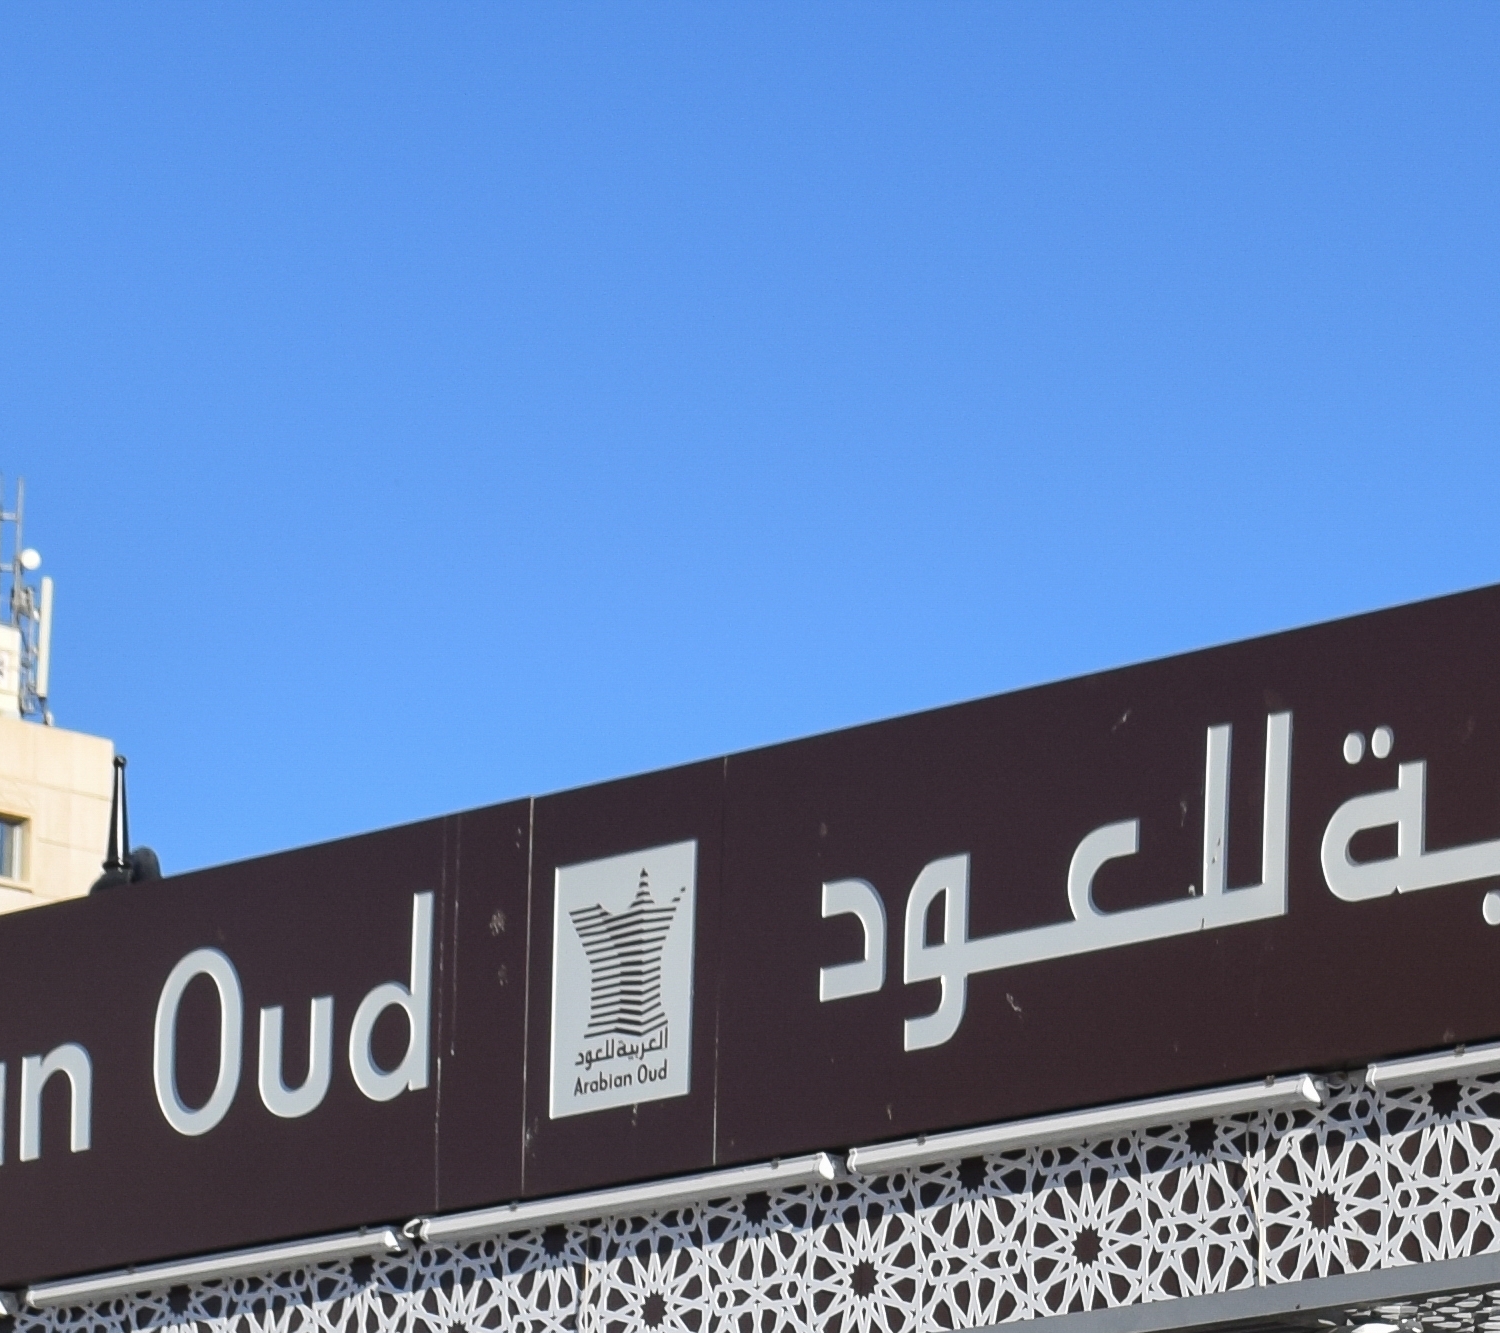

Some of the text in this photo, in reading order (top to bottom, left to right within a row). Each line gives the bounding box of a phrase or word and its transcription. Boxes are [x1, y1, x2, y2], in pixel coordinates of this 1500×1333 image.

[818, 710, 1293, 1052] للعود
[152, 891, 434, 1137] Oud
[573, 1058, 668, 1097] Arabian Oud
[574, 1026, 669, 1071] العربية للعود
